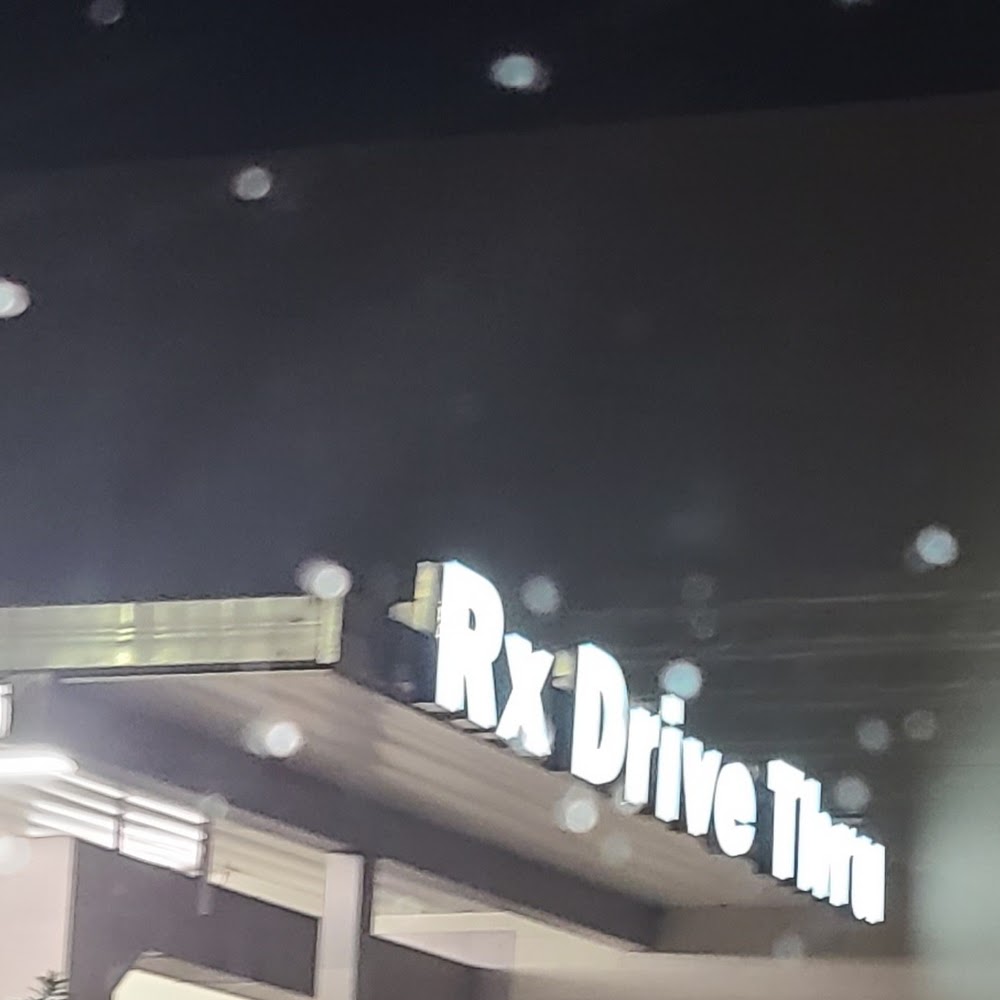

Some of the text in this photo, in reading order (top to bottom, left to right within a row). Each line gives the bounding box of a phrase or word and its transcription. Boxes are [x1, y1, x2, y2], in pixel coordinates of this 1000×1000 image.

[435, 560, 886, 925] Rx Drive Thru
